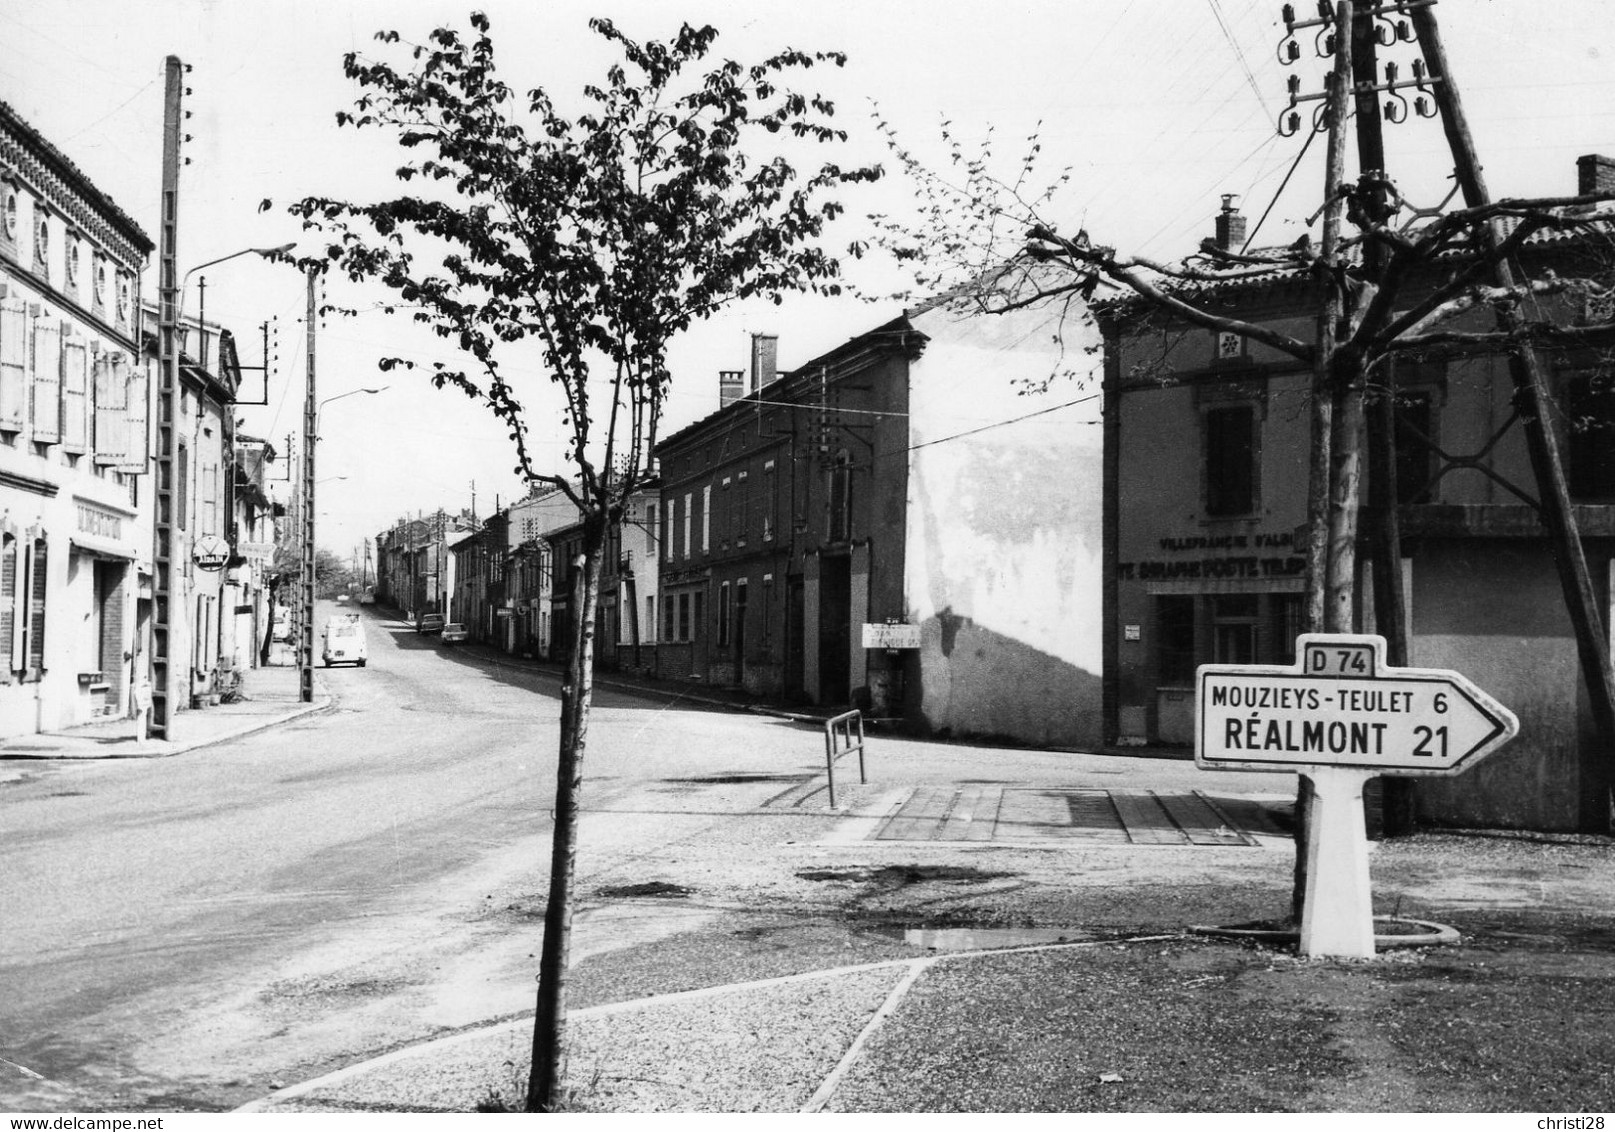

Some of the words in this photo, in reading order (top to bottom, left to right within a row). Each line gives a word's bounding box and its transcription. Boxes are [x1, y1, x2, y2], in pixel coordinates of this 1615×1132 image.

[1255, 533, 1293, 548] D'ALBI
[1201, 556, 1259, 578] POSTE
[1312, 649, 1327, 672] D
[1337, 650, 1366, 673] 74
[1212, 686, 1414, 714] MOUZIEYS-TEULET
[1433, 692, 1448, 714] 6
[1225, 710, 1388, 755] RÉALMONT
[1412, 725, 1448, 758] 21
